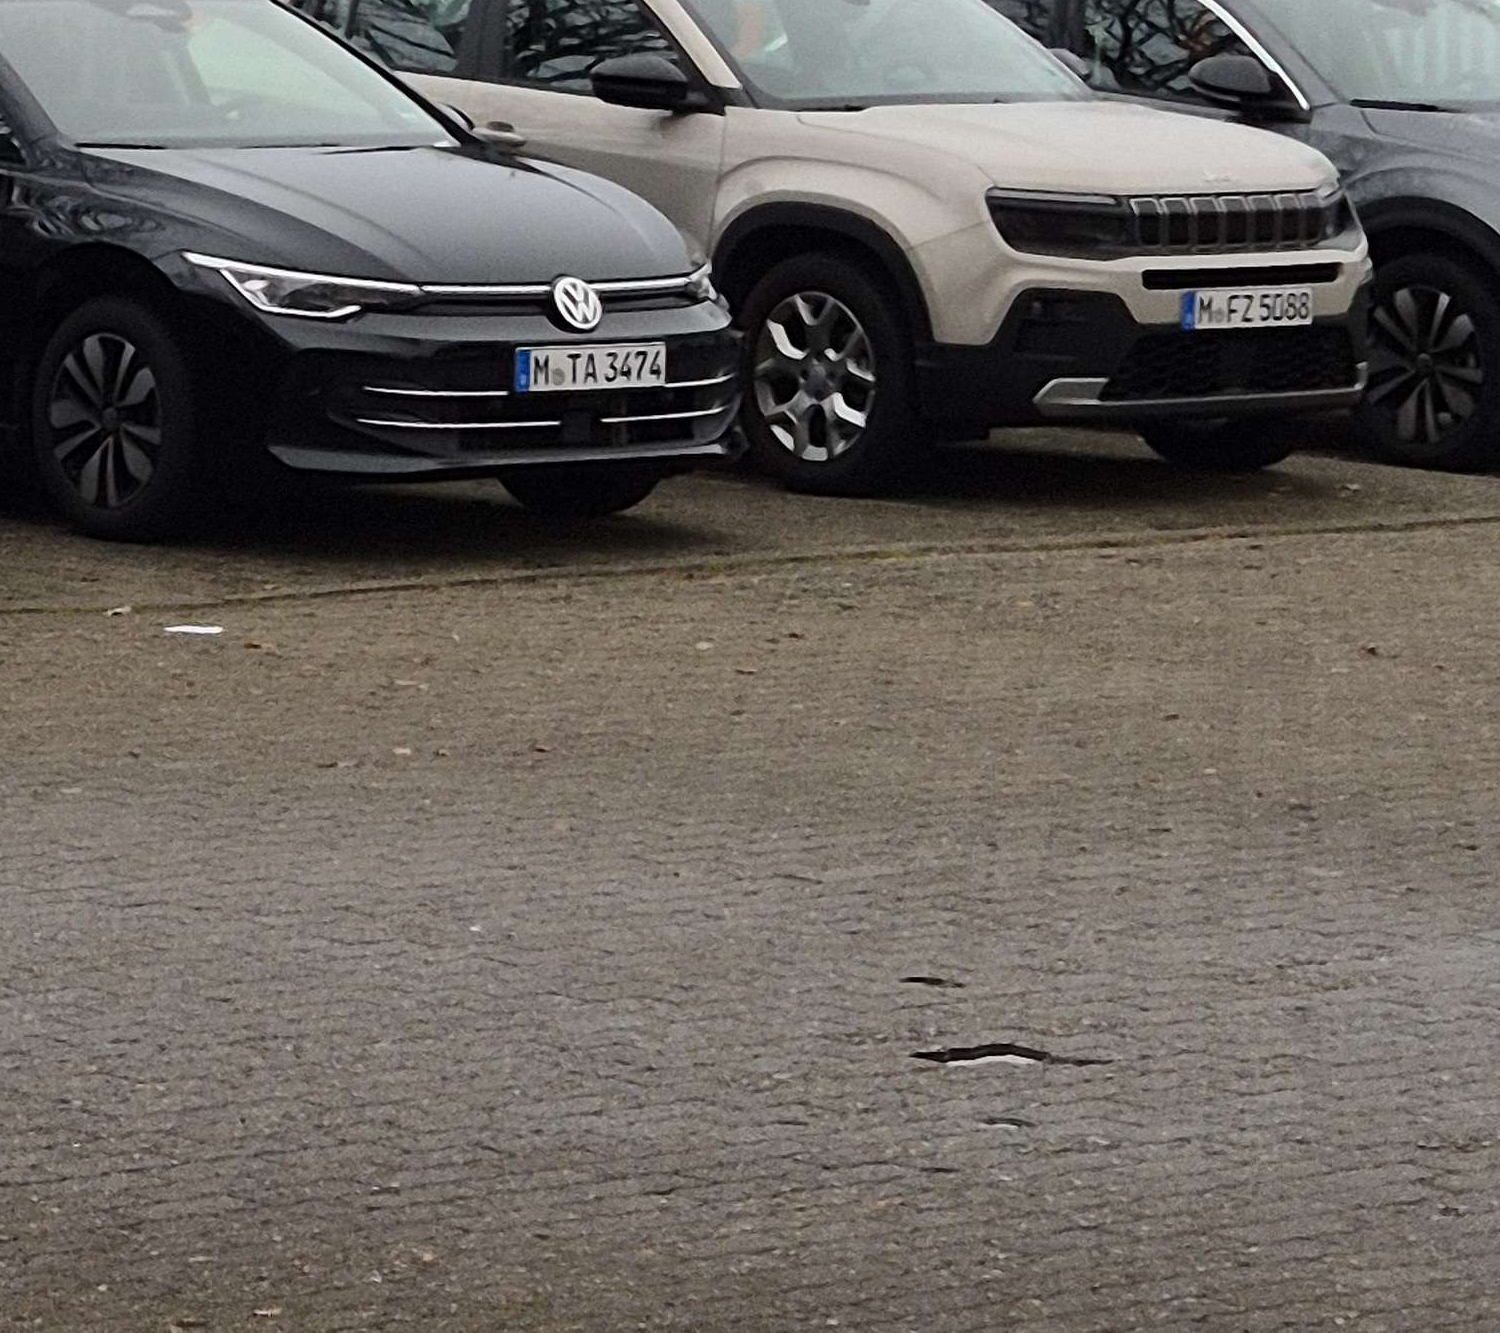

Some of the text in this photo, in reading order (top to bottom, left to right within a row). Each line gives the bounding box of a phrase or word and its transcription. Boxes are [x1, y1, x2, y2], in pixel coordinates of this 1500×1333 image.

[1198, 295, 1213, 323] M
[1227, 294, 1255, 323] FZ
[533, 349, 662, 386] M TA 3474
